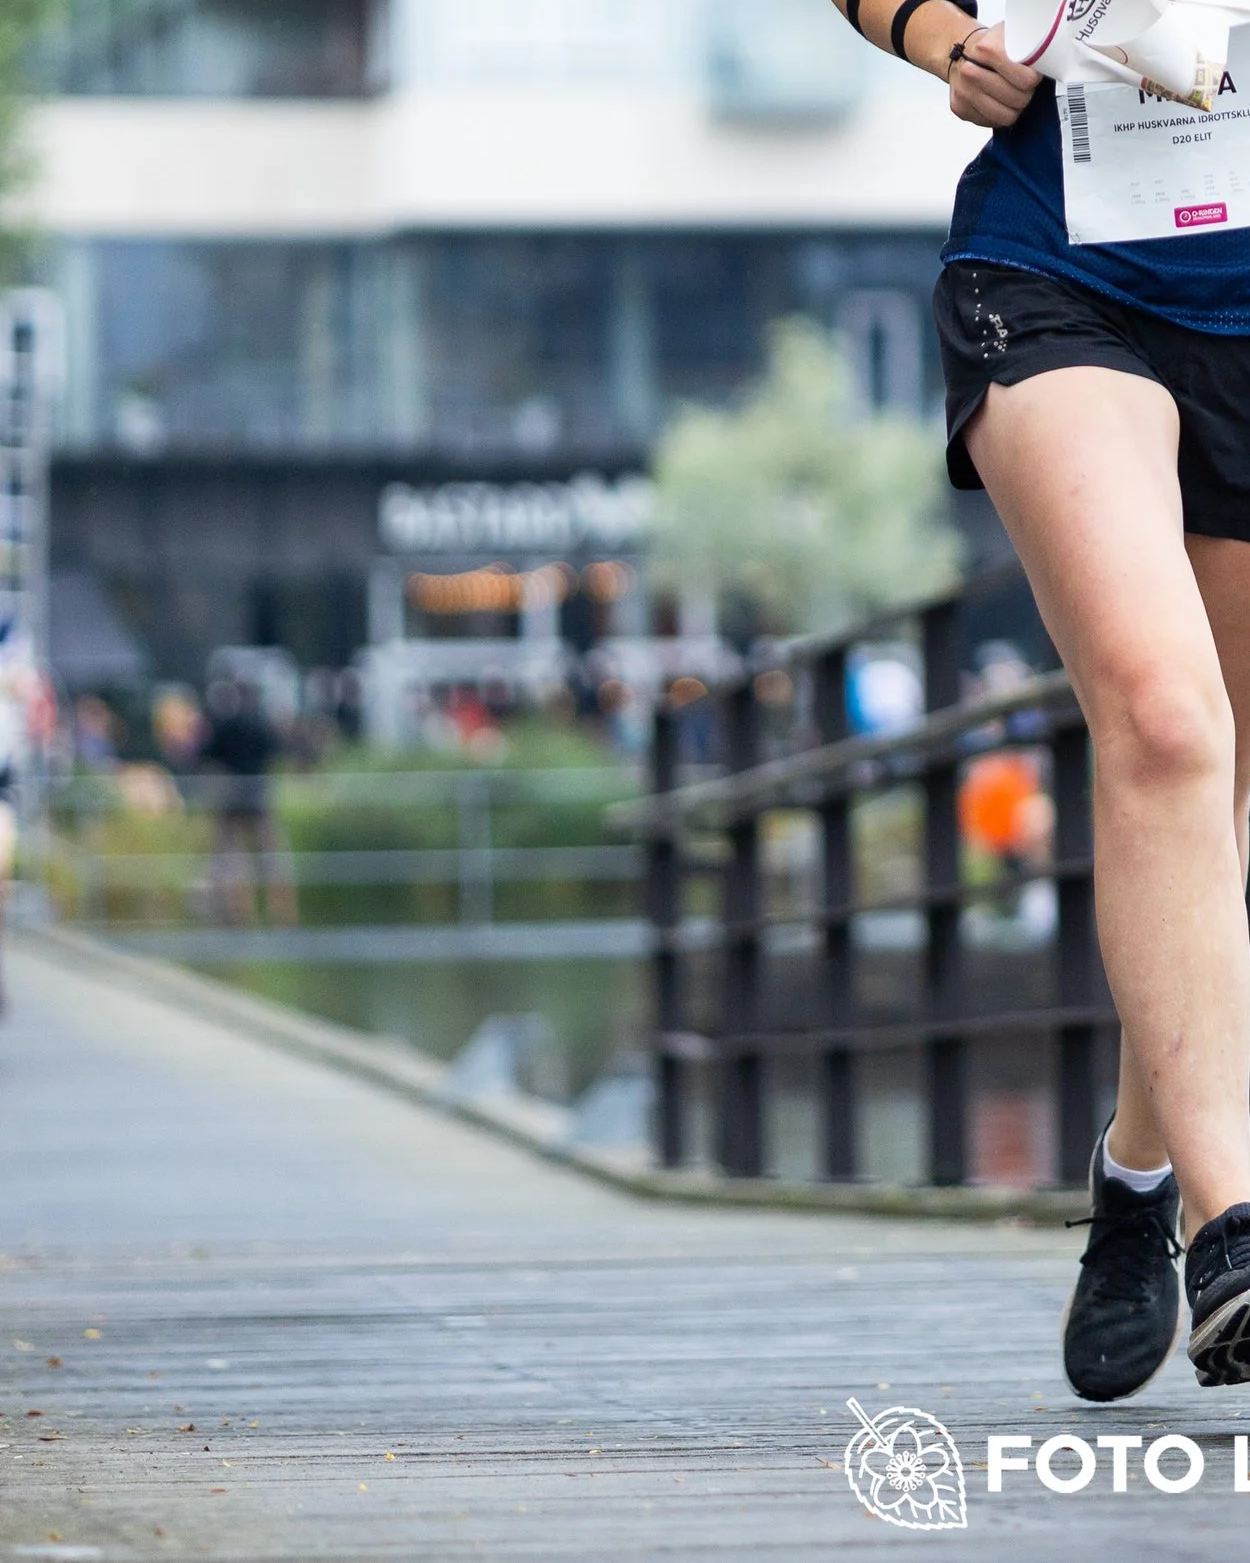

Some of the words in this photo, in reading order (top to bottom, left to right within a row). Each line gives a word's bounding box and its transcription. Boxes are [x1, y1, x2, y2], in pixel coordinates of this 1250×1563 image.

[1114, 122, 1135, 132] IKHP
[1138, 116, 1196, 130] HUSKVARNA
[1172, 135, 1192, 144] D20
[1194, 132, 1212, 141] ELIT
